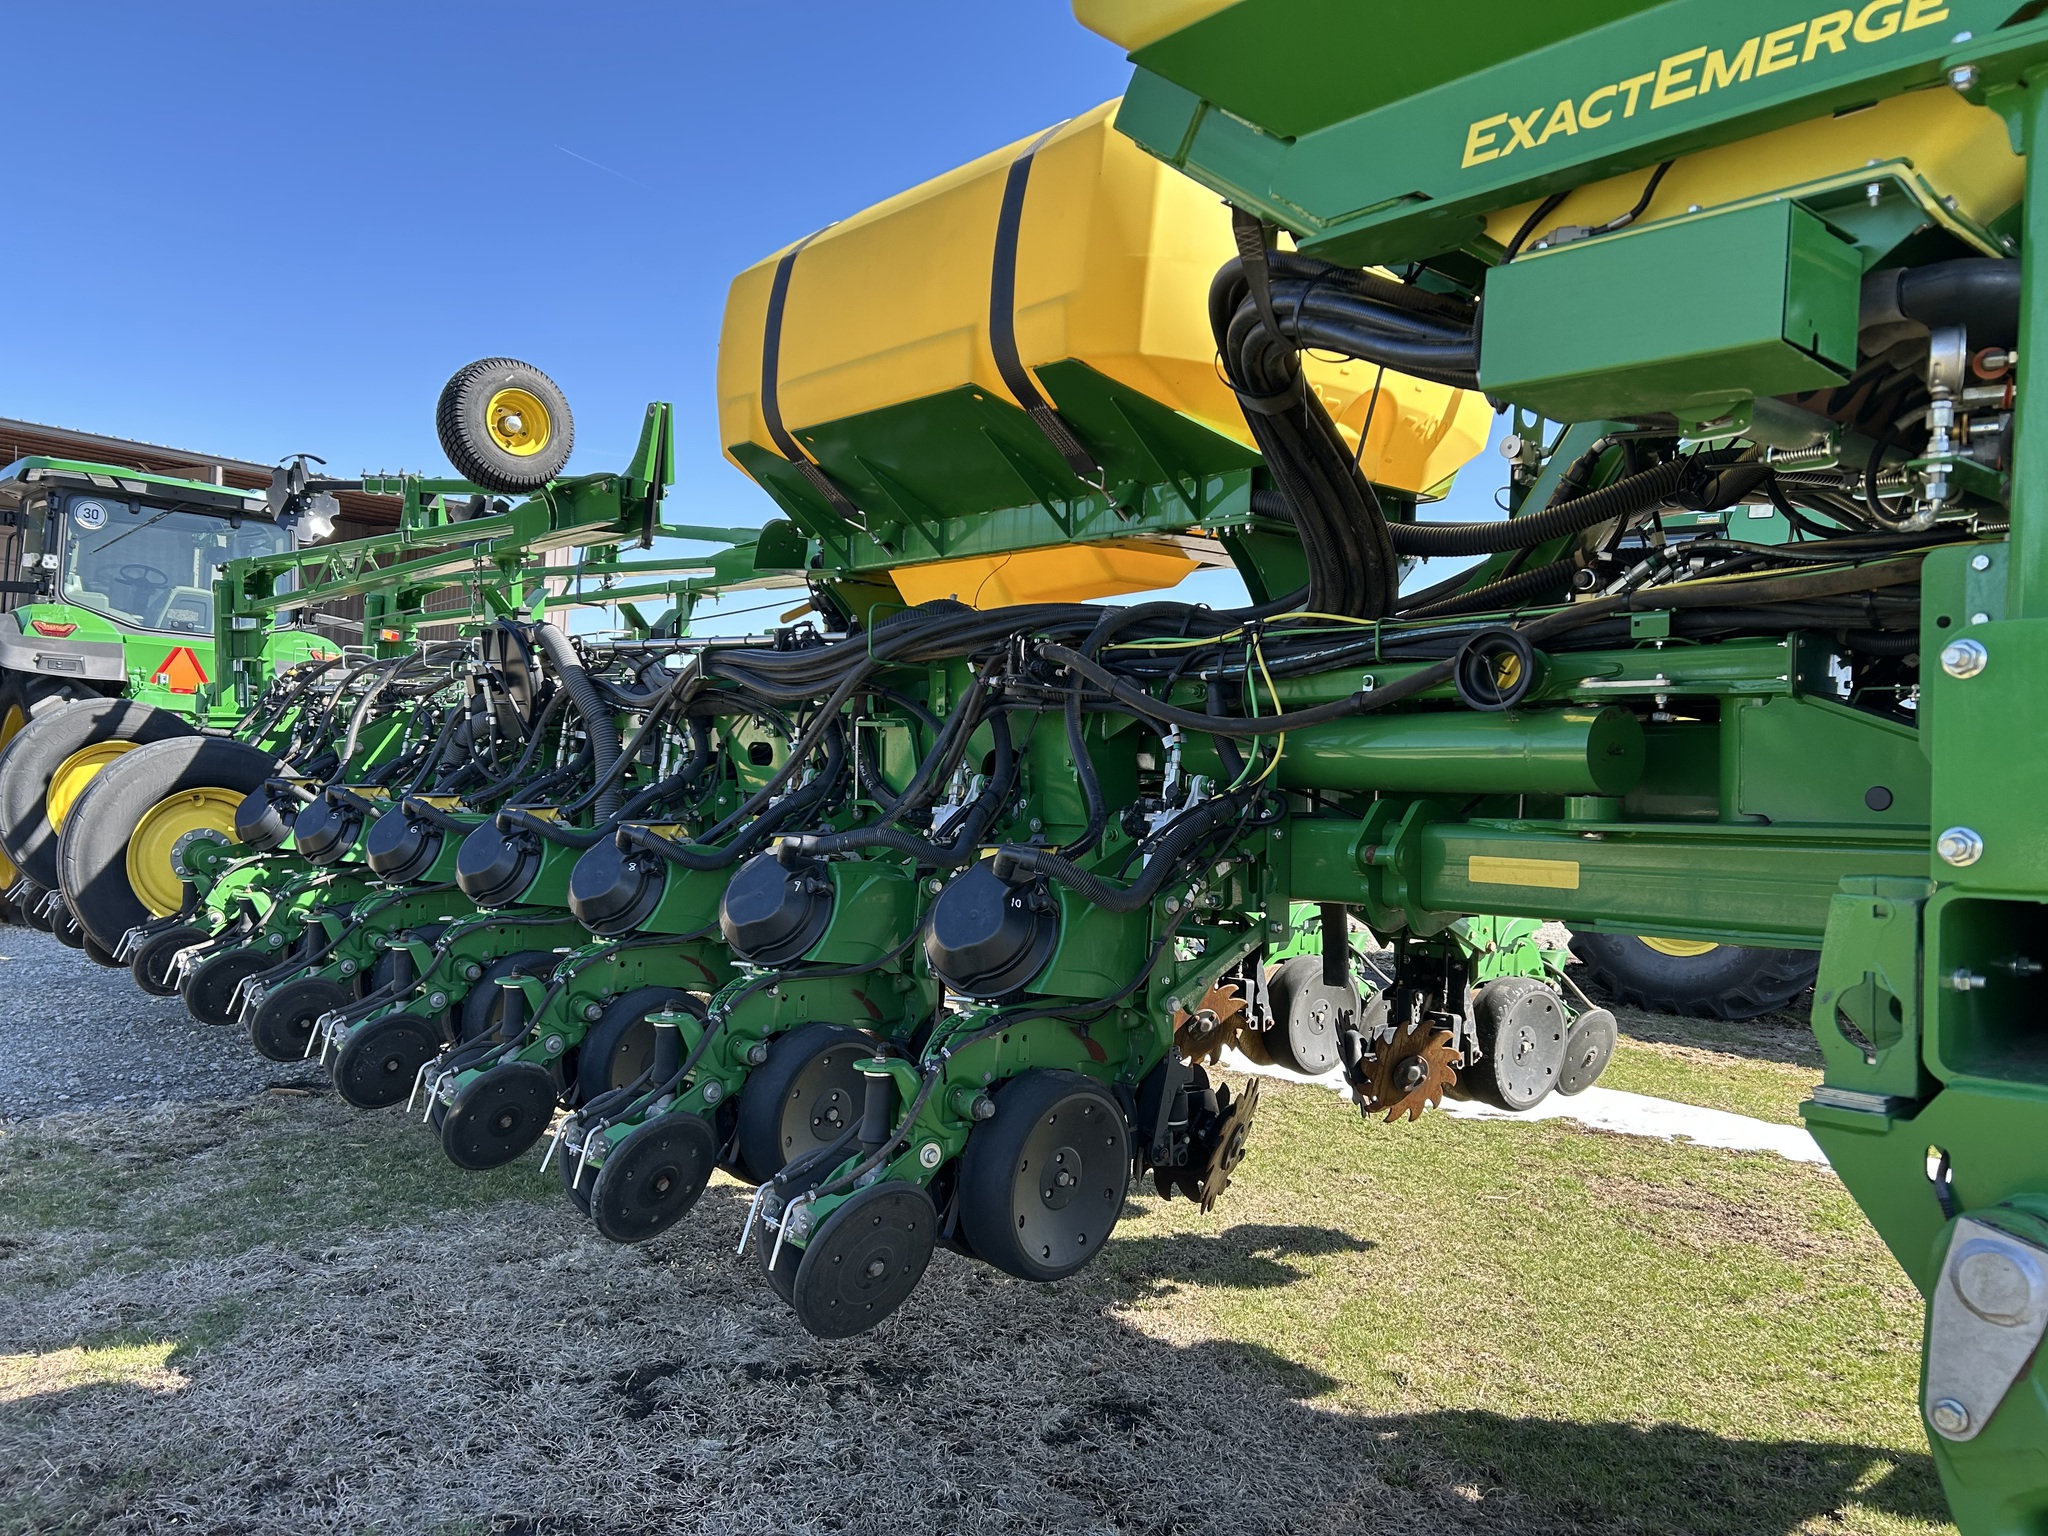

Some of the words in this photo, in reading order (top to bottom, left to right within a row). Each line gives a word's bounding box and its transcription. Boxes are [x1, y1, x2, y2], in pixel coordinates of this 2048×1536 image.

[83, 508, 99, 520] 30
[331, 812, 339, 820] 5
[410, 825, 418, 834] 6
[505, 842, 512, 851] 7
[628, 862, 637, 871] 8
[794, 880, 801, 892] 9
[1011, 897, 1022, 908] 10
